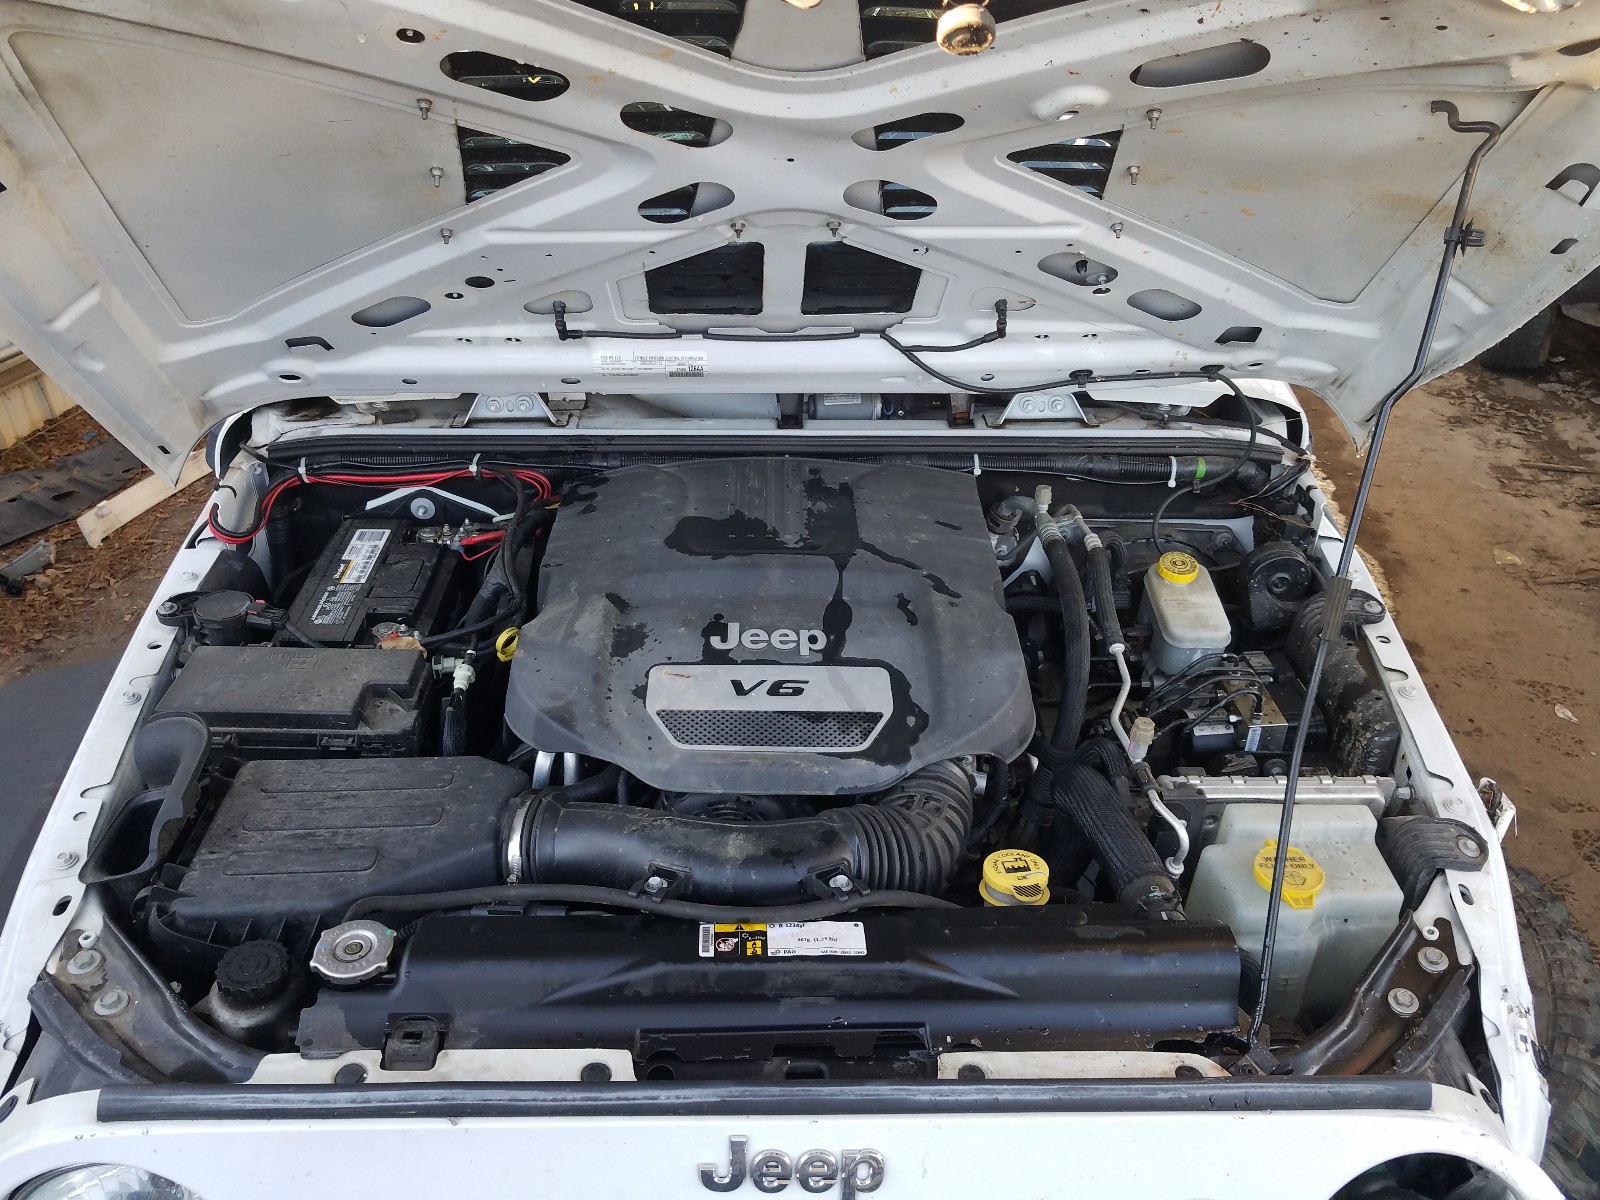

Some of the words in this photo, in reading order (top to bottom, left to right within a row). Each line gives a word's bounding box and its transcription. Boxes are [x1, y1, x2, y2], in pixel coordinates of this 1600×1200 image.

[709, 622, 827, 656] Jeep
[730, 679, 810, 697] V6
[1030, 858, 1041, 870] ONLY
[698, 1134, 885, 1200] Jeep
